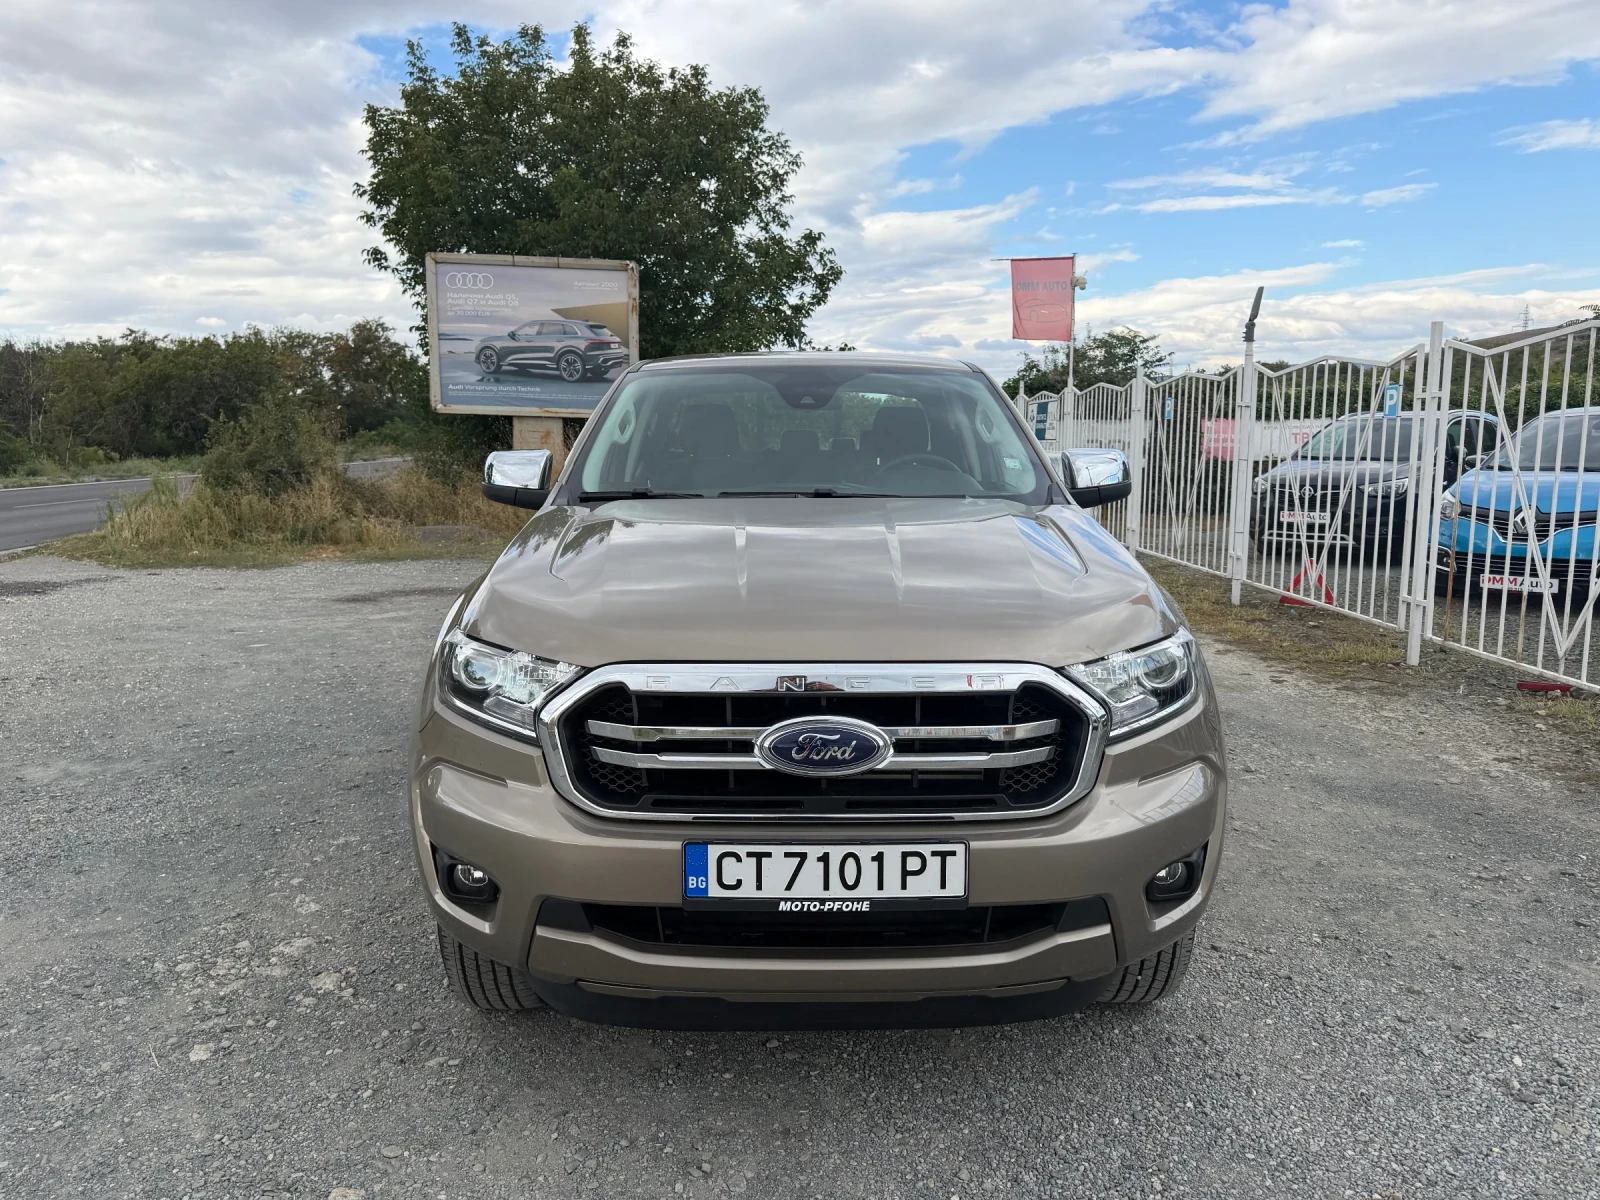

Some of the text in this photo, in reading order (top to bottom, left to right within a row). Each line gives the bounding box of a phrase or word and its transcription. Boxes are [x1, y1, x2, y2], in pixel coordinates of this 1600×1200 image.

[1016, 281, 1068, 292] DMM AUTO
[1386, 390, 1398, 415] P
[646, 675, 1005, 691] RANGER
[791, 733, 857, 760] Ford
[688, 876, 706, 889] BG
[778, 901, 870, 912] MOTO-PFOHE
